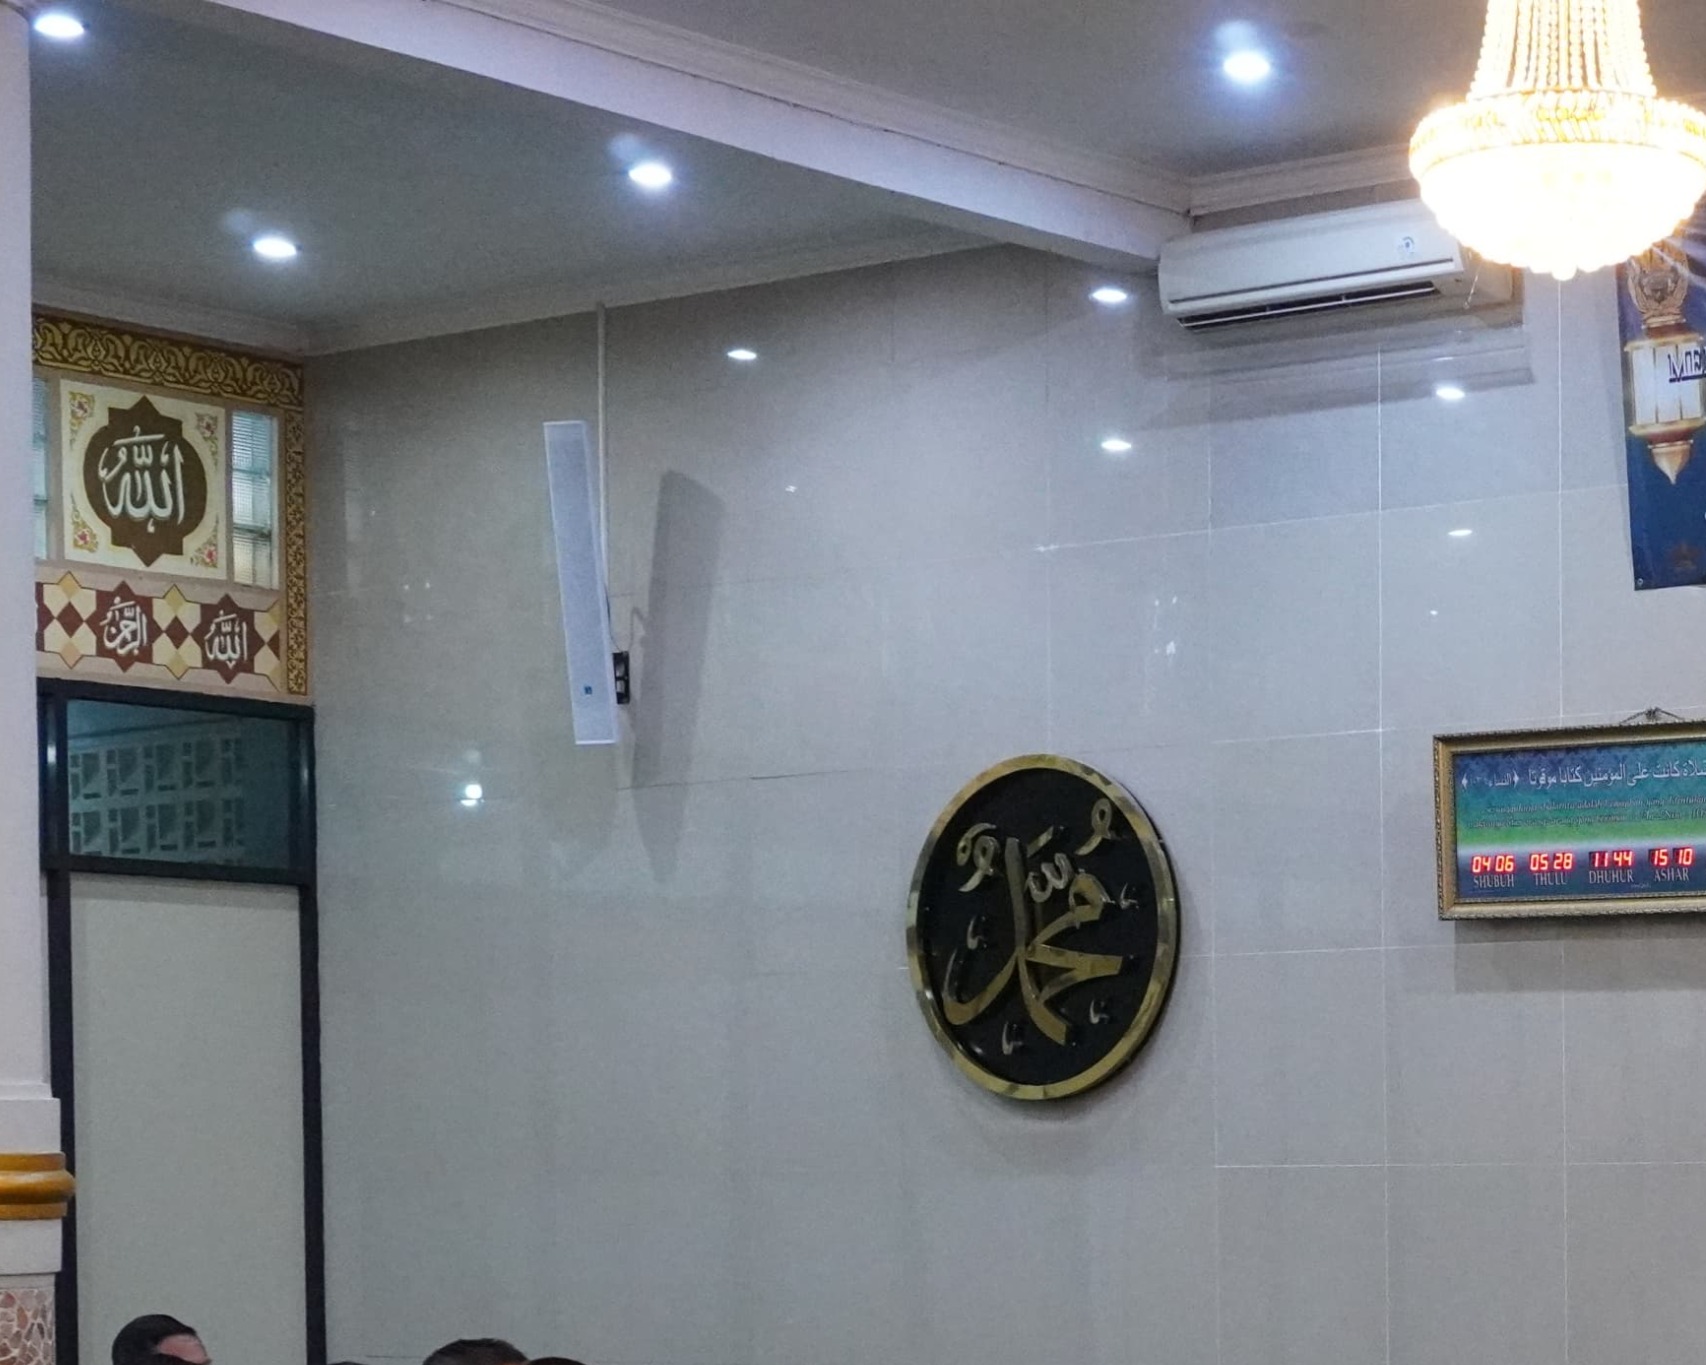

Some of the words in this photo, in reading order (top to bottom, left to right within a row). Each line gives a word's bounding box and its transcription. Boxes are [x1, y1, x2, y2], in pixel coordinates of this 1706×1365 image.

[1473, 873, 1515, 889] SHUBUH
[1588, 869, 1635, 884] DHUHUR
[1654, 866, 1690, 882] ASHAR
